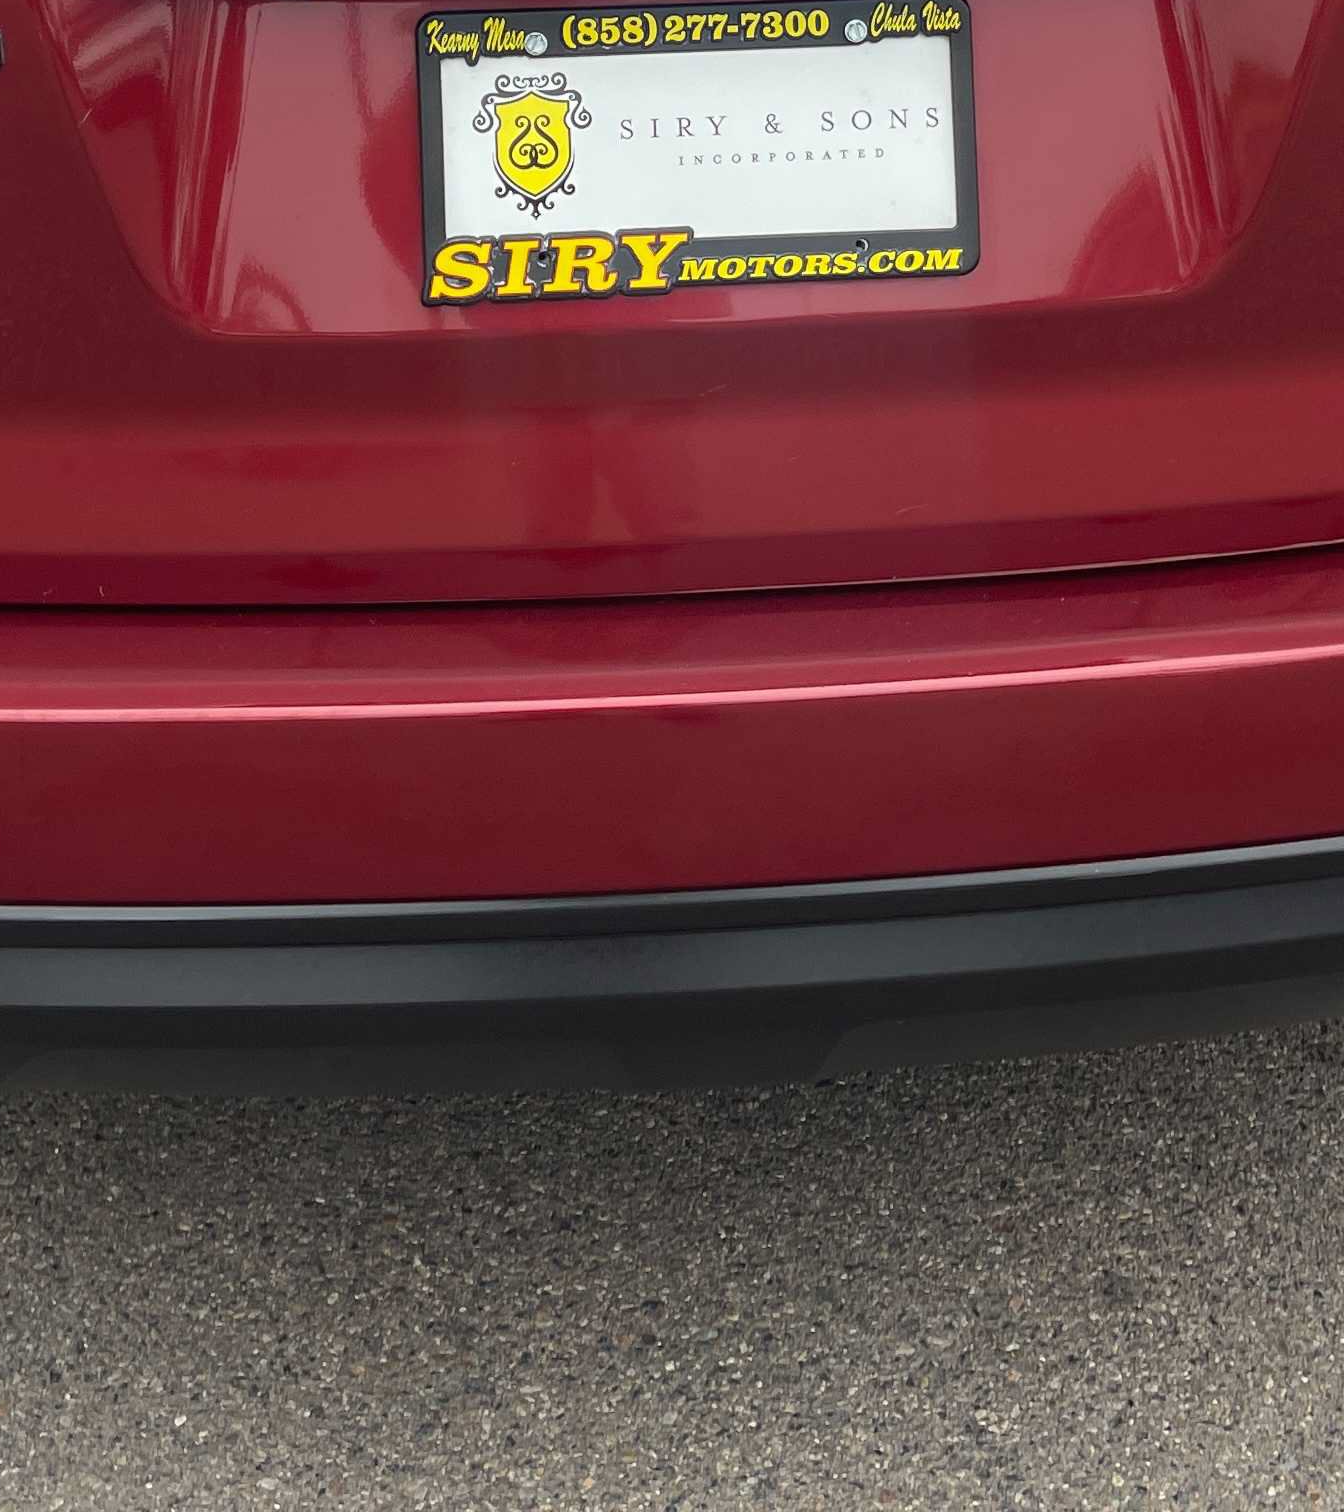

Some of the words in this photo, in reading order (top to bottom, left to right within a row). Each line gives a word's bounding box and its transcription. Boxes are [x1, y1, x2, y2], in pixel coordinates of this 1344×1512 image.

[426, 20, 481, 59] Kearny
[483, 17, 526, 52] Mesa
[561, 11, 658, 50] (858)
[663, 8, 830, 46] 277-7300
[869, 0, 917, 36] Chula
[921, 0, 963, 33] Vista
[618, 114, 728, 141] SIRY
[764, 112, 784, 135] &
[820, 106, 941, 132] SONS
[678, 147, 888, 167] INCORPORATED
[428, 229, 692, 299] SIRY
[678, 248, 965, 281] MOTORS.COM
